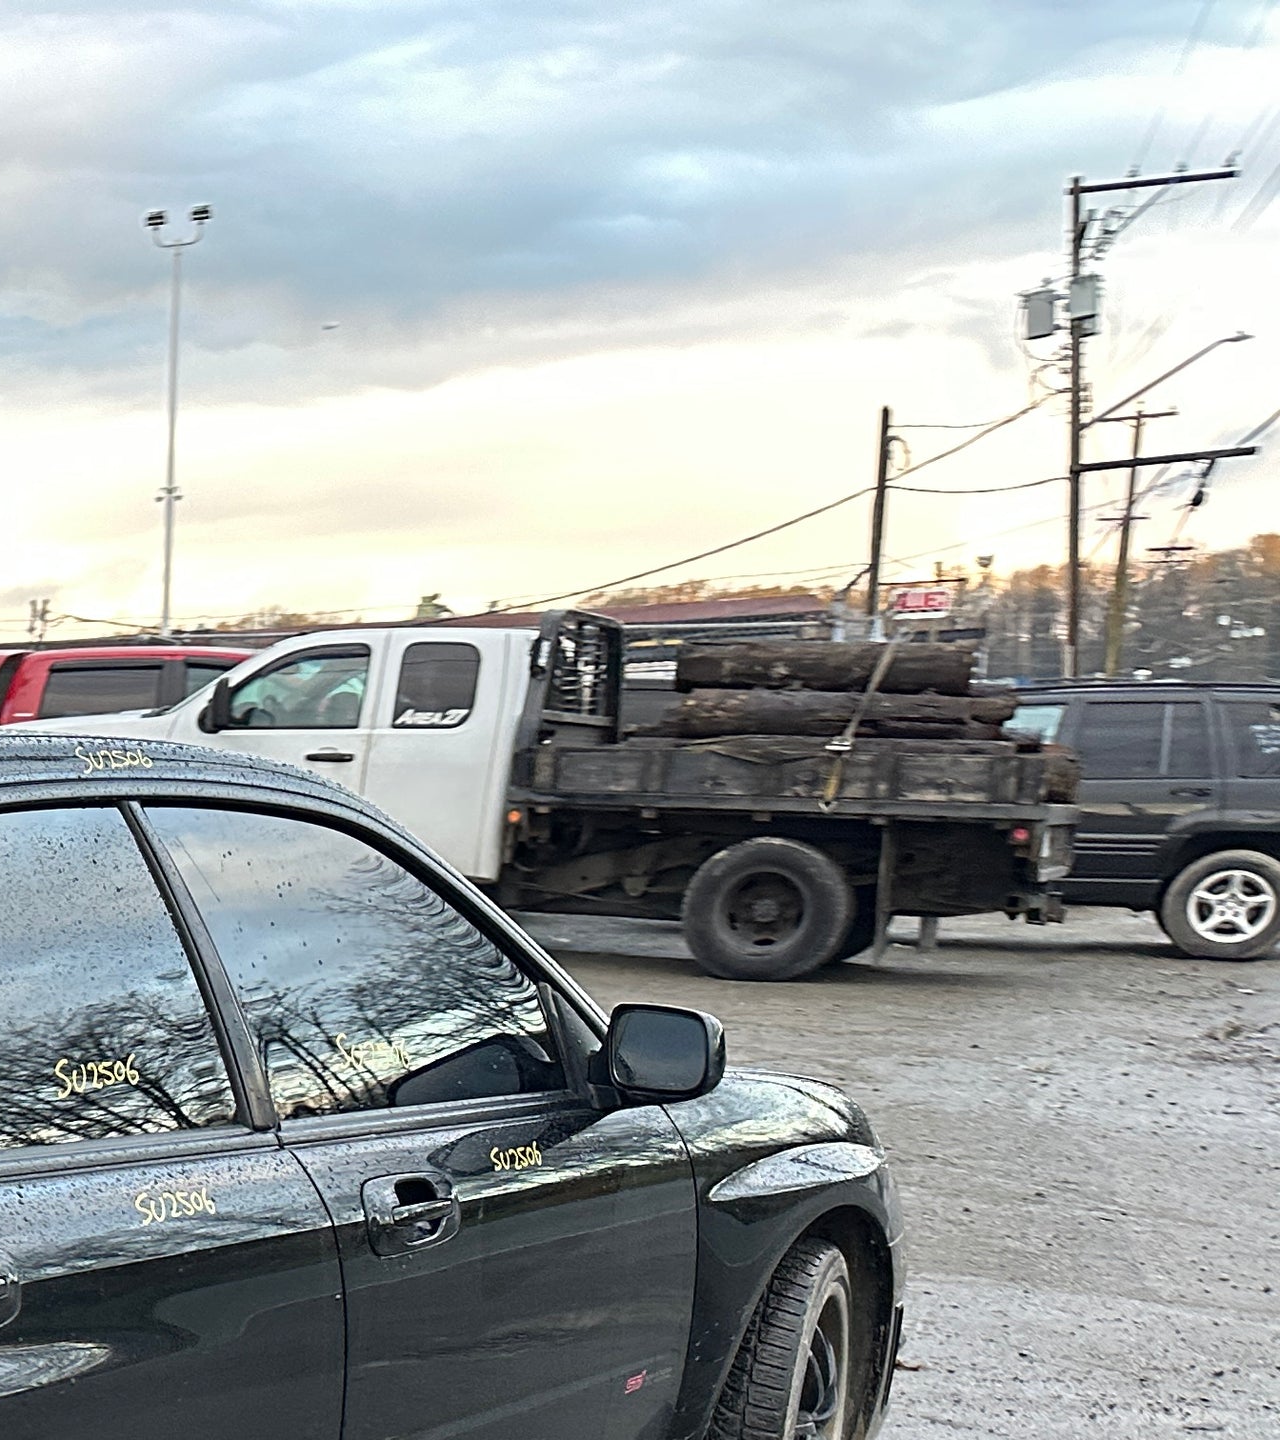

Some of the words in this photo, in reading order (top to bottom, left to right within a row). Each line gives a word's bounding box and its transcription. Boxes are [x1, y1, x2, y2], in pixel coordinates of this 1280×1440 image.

[75, 746, 154, 775] SU2506
[54, 1053, 140, 1100] SU2506
[490, 1140, 543, 1172] SU2506
[135, 1187, 217, 1228] SU2506
